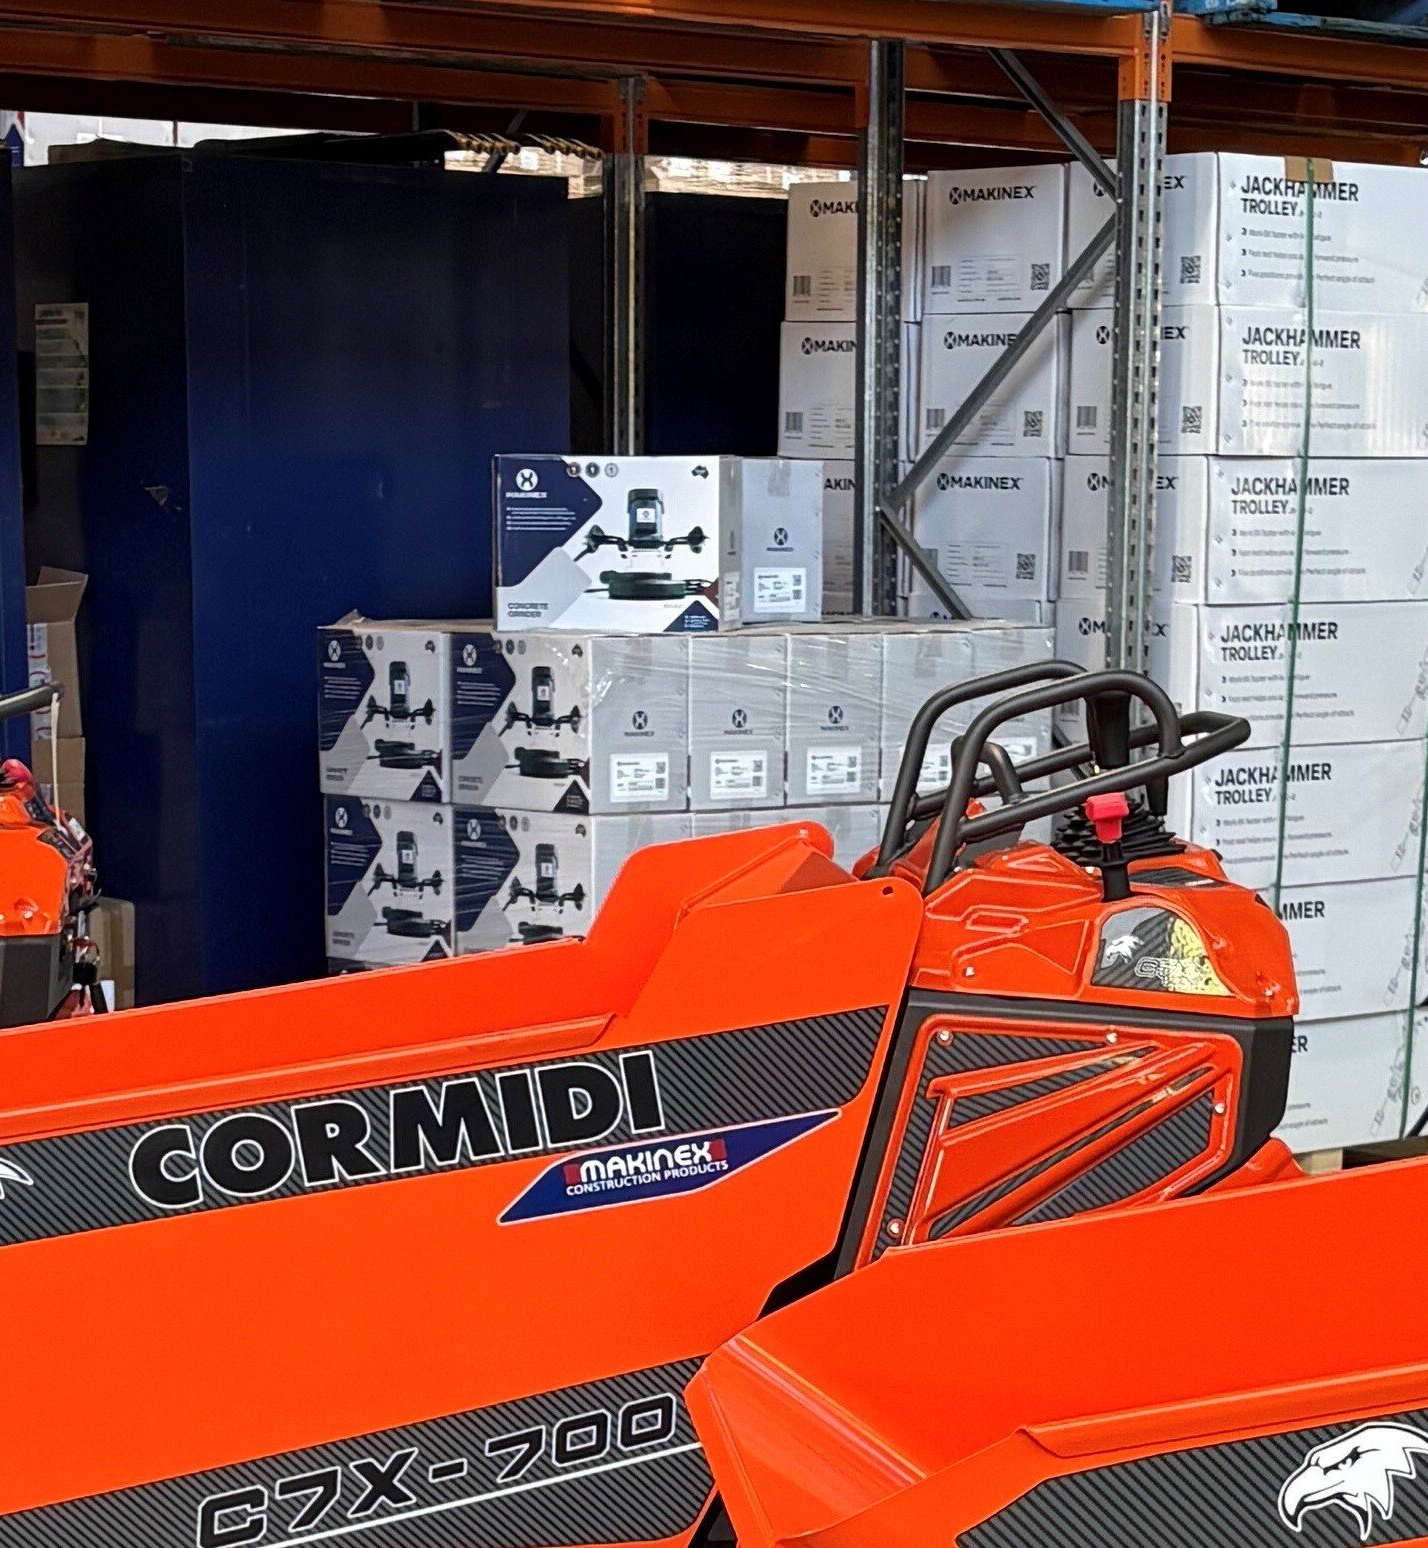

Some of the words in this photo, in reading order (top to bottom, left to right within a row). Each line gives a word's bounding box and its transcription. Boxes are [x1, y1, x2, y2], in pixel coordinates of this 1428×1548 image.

[963, 185, 1036, 201] MAKINEX
[1241, 198, 1298, 216] TROLLEY
[957, 333, 1017, 346] MAKINE
[1242, 349, 1300, 366] TROLLEY
[951, 476, 1021, 490] MAKINEX
[1231, 500, 1289, 514] TROLLEY
[1221, 645, 1278, 661] TROLLEY
[1215, 788, 1272, 805] TROLLEY
[129, 1050, 666, 1208] CORMIDI
[579, 1141, 713, 1183] MAKINEX
[566, 1167, 661, 1196] CONSTRUCTION
[664, 1160, 729, 1179] PRODUCTS
